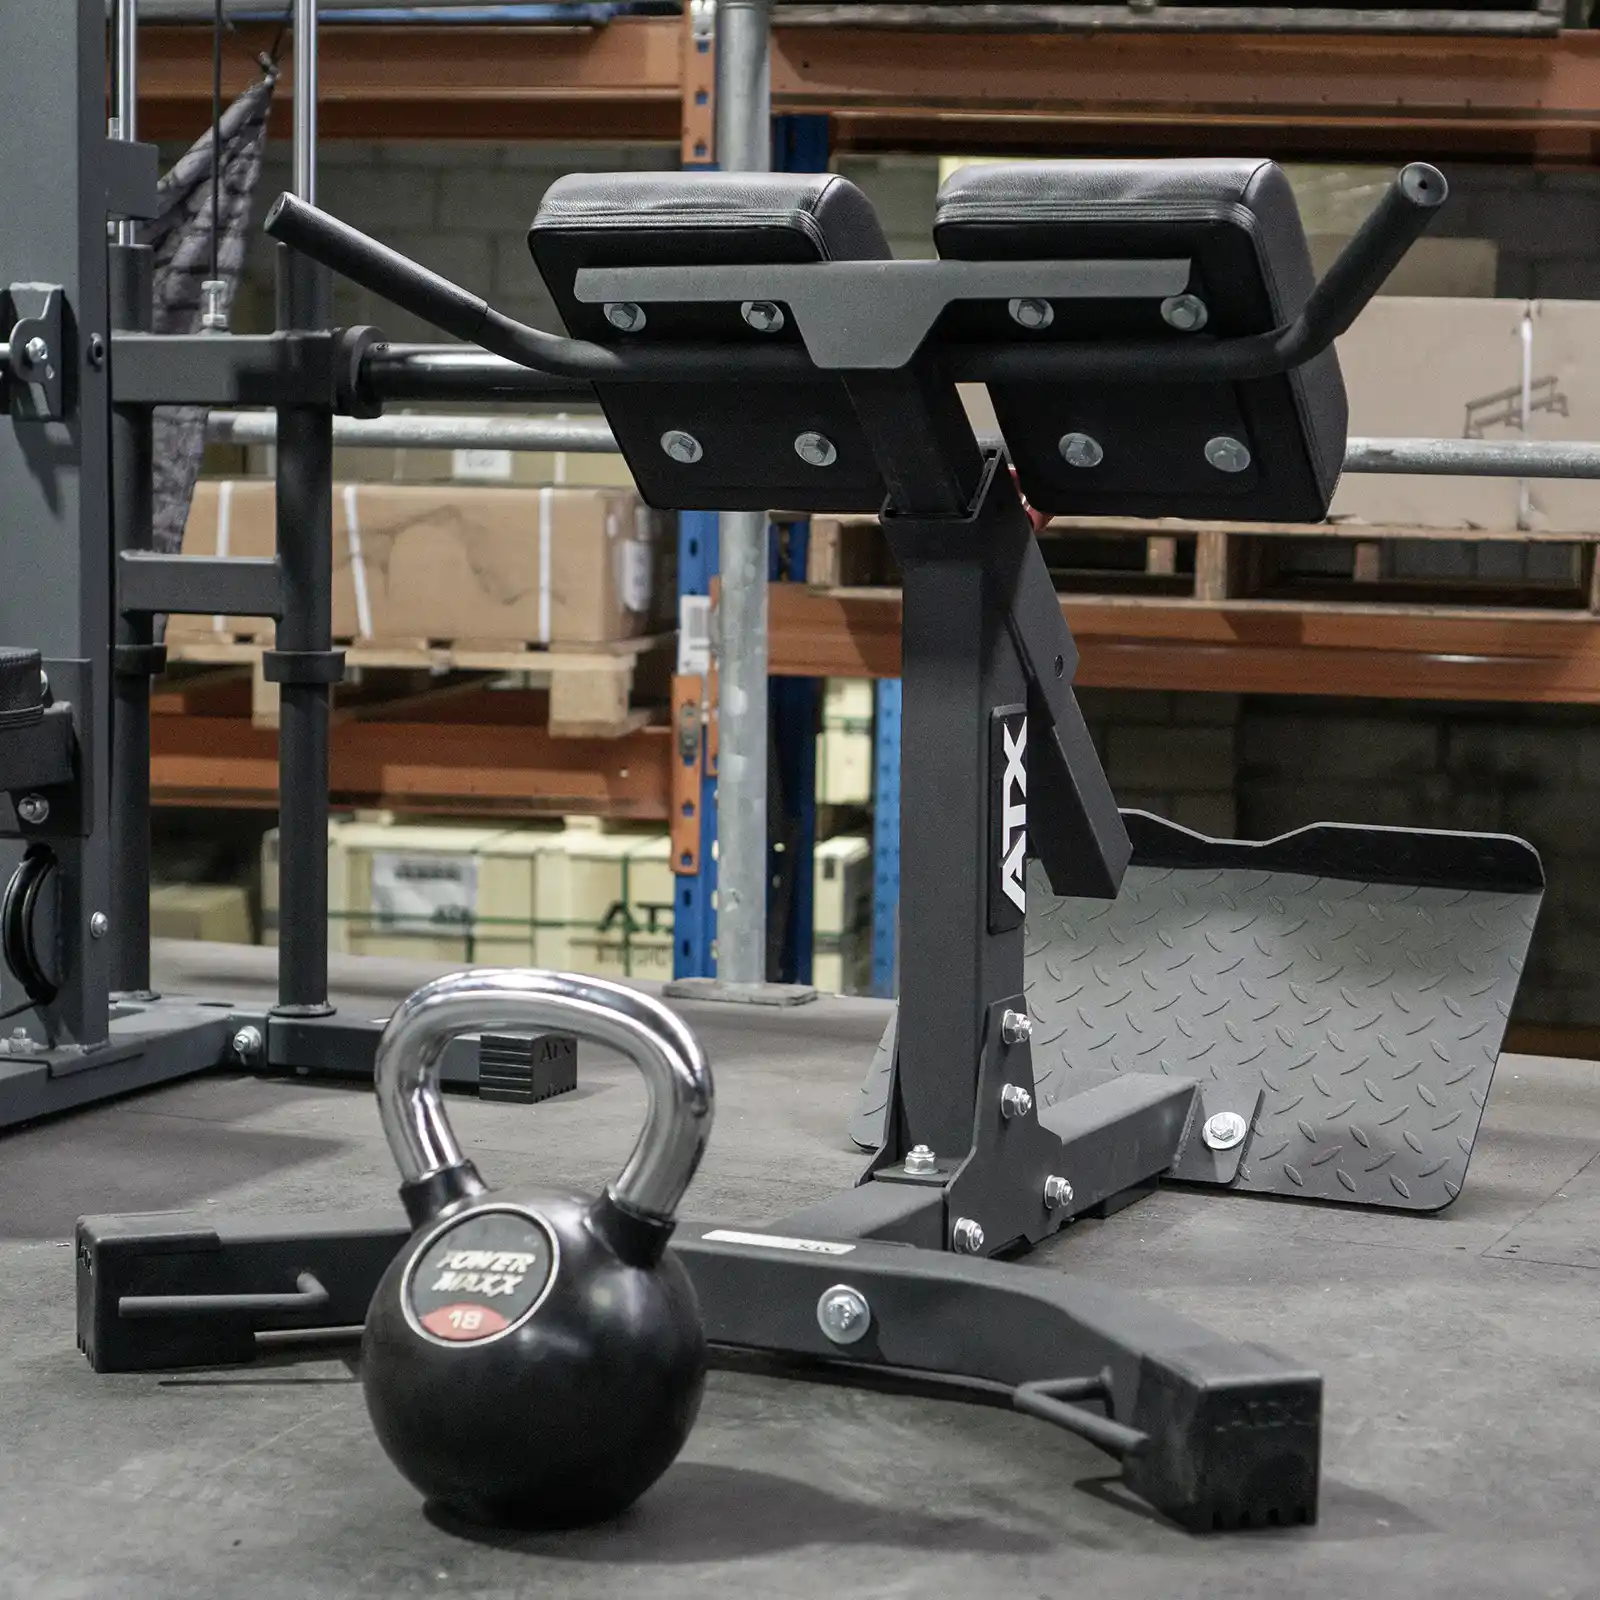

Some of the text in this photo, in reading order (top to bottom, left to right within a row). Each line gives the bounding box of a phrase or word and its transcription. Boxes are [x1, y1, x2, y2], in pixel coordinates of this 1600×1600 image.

[1002, 716, 1027, 914] ATX
[436, 1250, 536, 1273] POWER
[431, 1271, 524, 1298] MAXX
